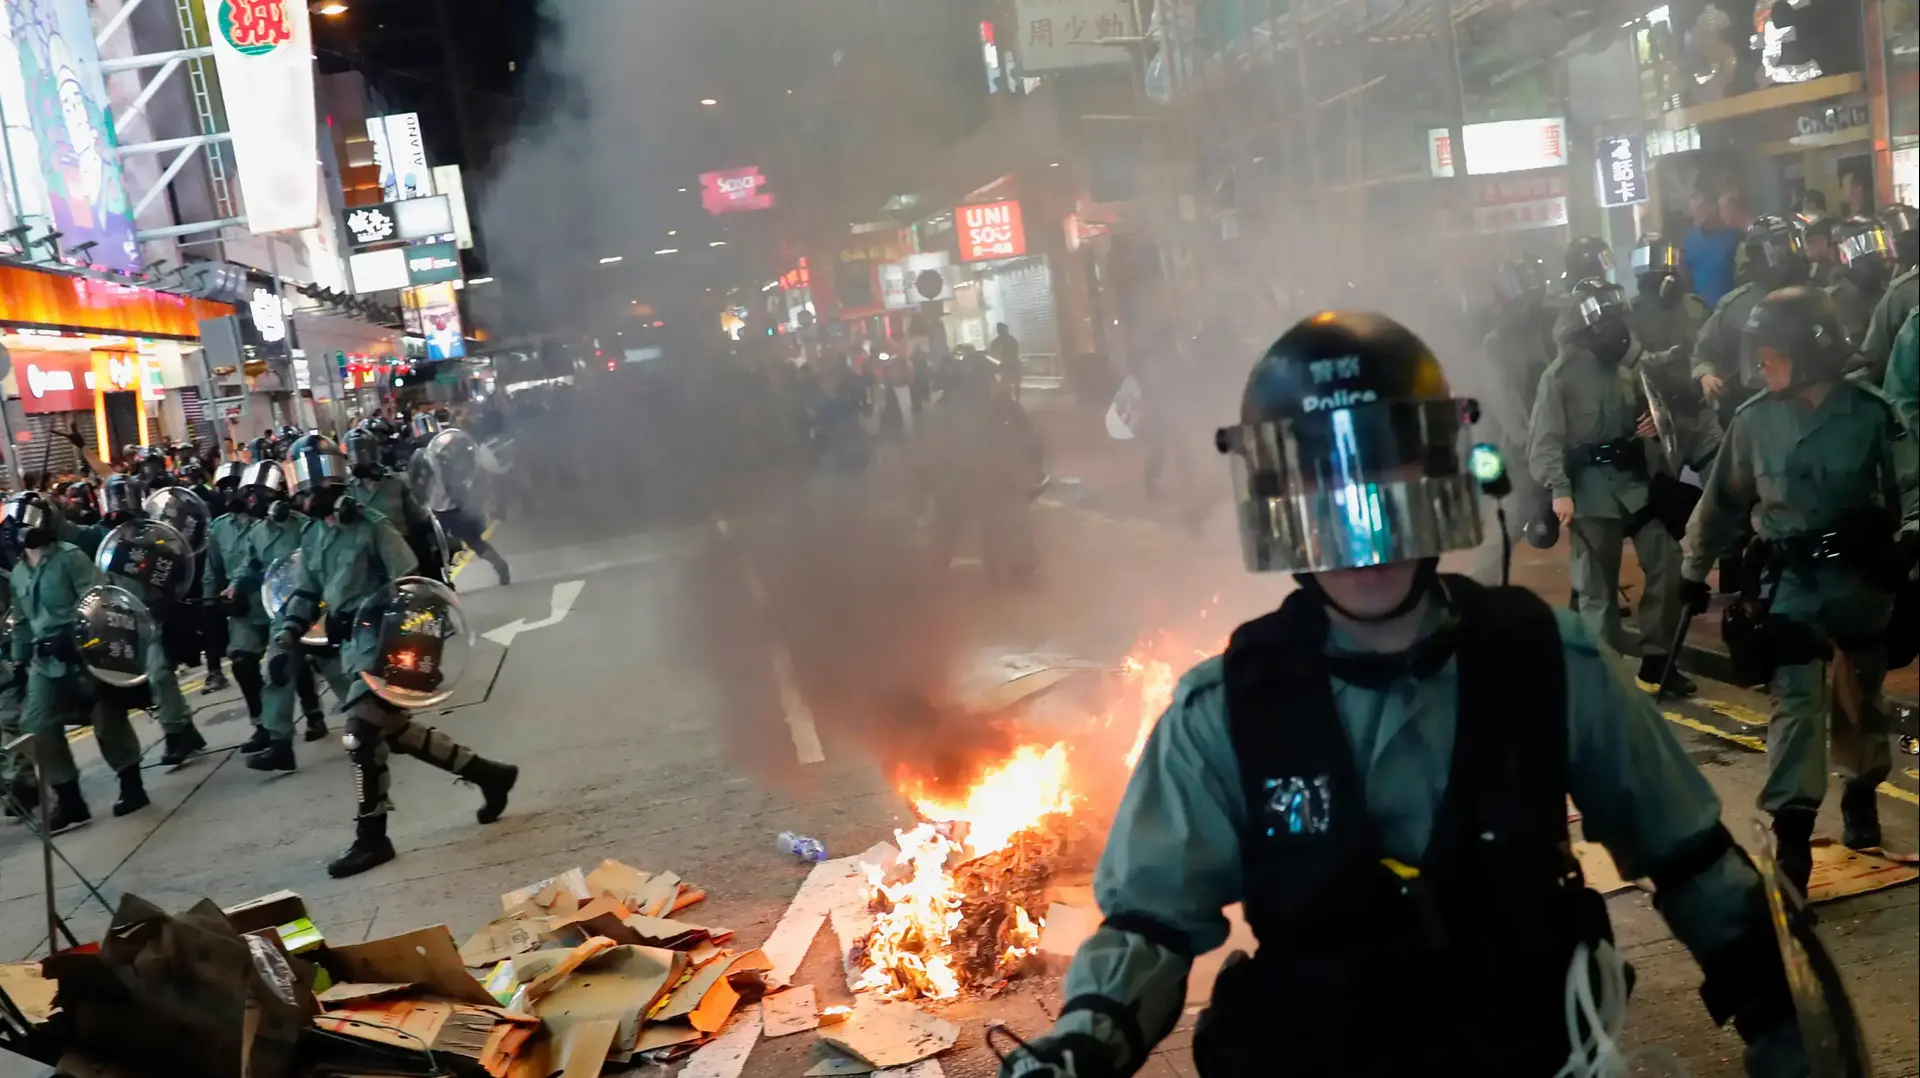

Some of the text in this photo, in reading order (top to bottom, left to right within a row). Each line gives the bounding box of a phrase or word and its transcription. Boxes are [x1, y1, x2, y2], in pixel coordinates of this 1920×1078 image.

[406, 116, 424, 166] ALAND
[966, 205, 1010, 228] UNI
[1302, 388, 1378, 413] Police
